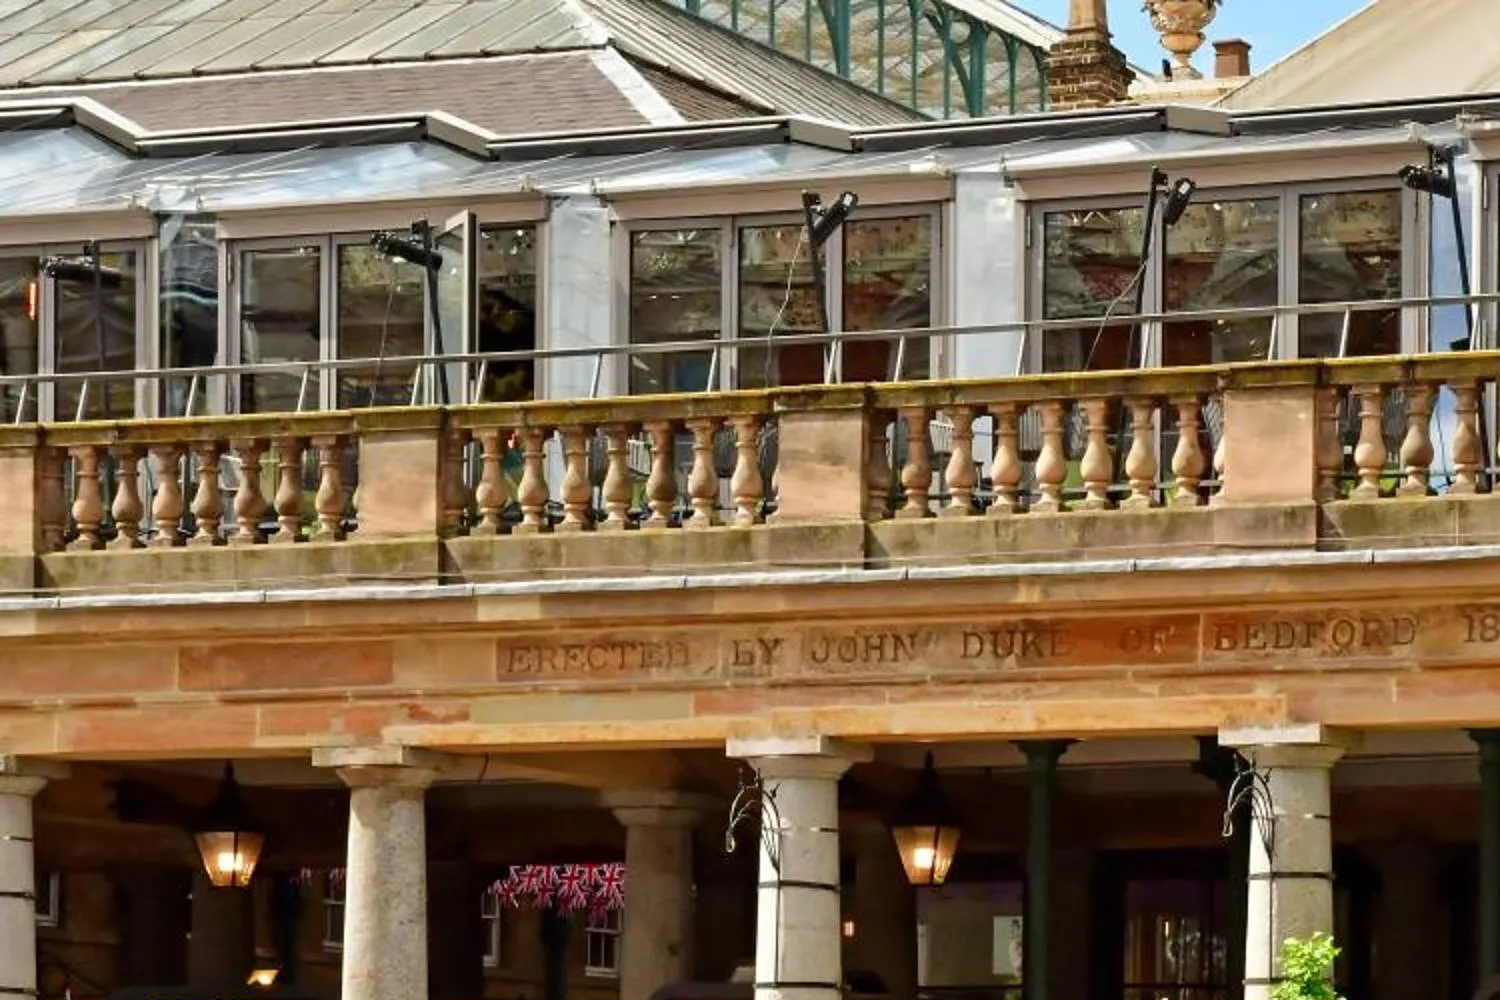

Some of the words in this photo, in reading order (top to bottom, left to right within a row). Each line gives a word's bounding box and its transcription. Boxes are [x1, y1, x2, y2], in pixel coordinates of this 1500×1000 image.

[731, 636, 785, 667] BY
[810, 632, 918, 664] JOHN
[960, 629, 1071, 661] DUKE
[1213, 616, 1420, 651] BEDFORD
